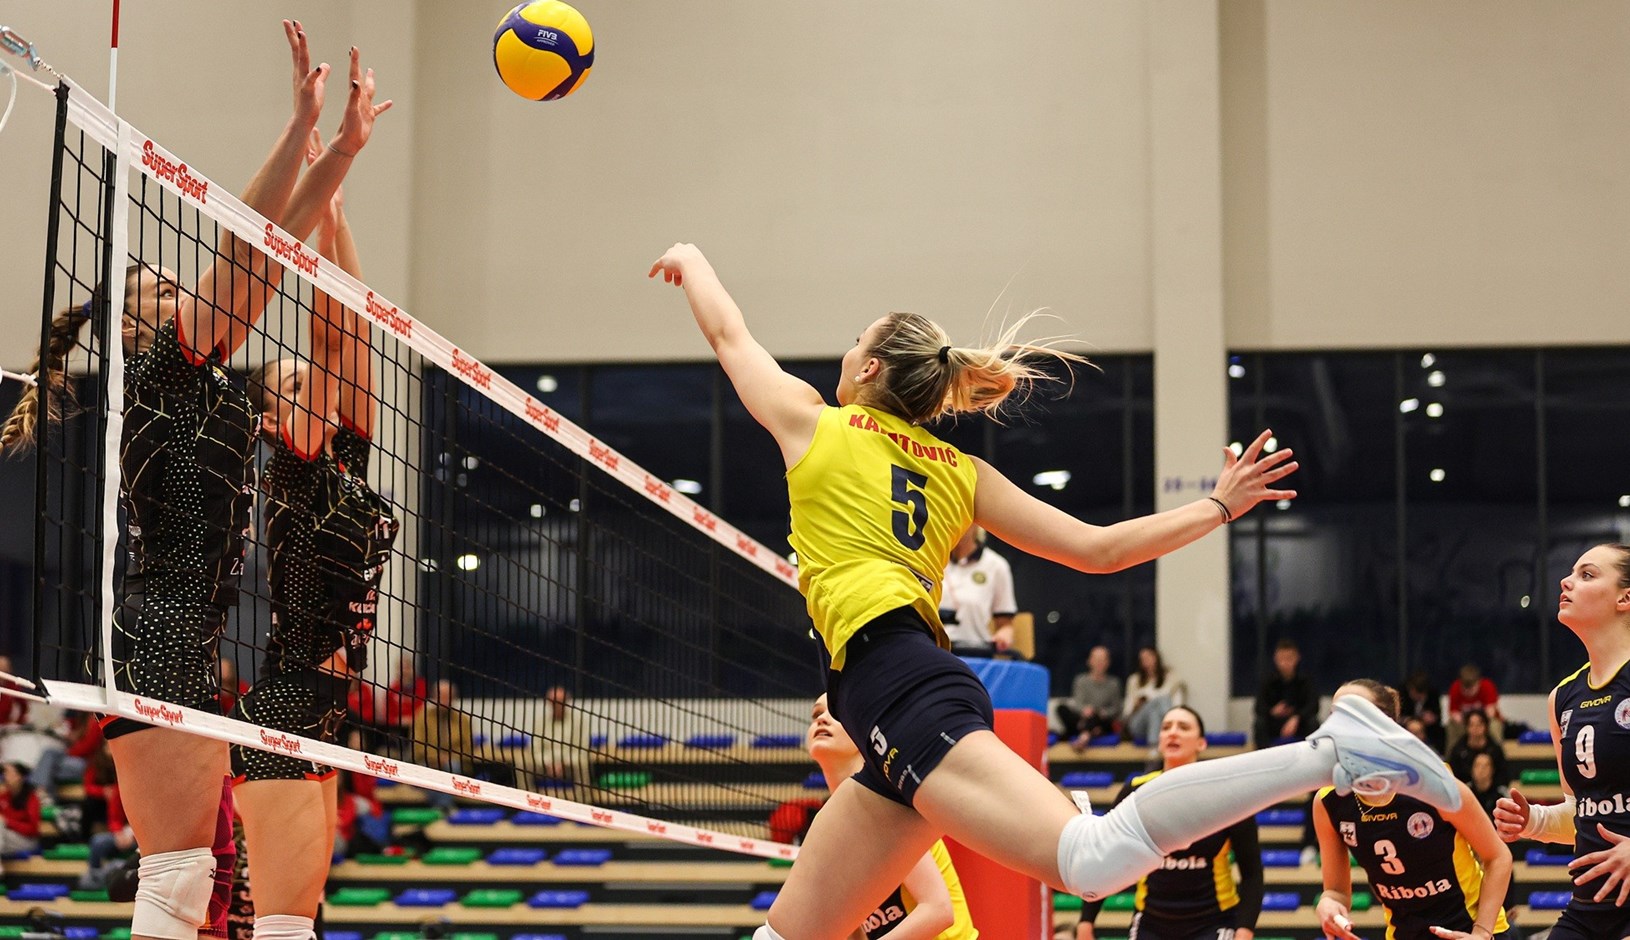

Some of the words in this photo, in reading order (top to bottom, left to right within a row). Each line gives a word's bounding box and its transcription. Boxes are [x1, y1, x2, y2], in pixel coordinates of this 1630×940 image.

[538, 29, 558, 41] FIVB
[142, 140, 208, 204] SuperSport
[264, 222, 319, 277] SuperSport
[365, 291, 412, 339] SuperSport
[452, 348, 491, 389] SuperSport
[891, 463, 929, 551] 5
[135, 699, 184, 725] SuperSport
[1580, 695, 1612, 709] GIVOVA
[260, 729, 301, 754] SuperSport
[870, 725, 888, 756] 5
[1575, 725, 1597, 779] 9
[1374, 840, 1405, 875] 3
[1376, 878, 1452, 900] Ribola
